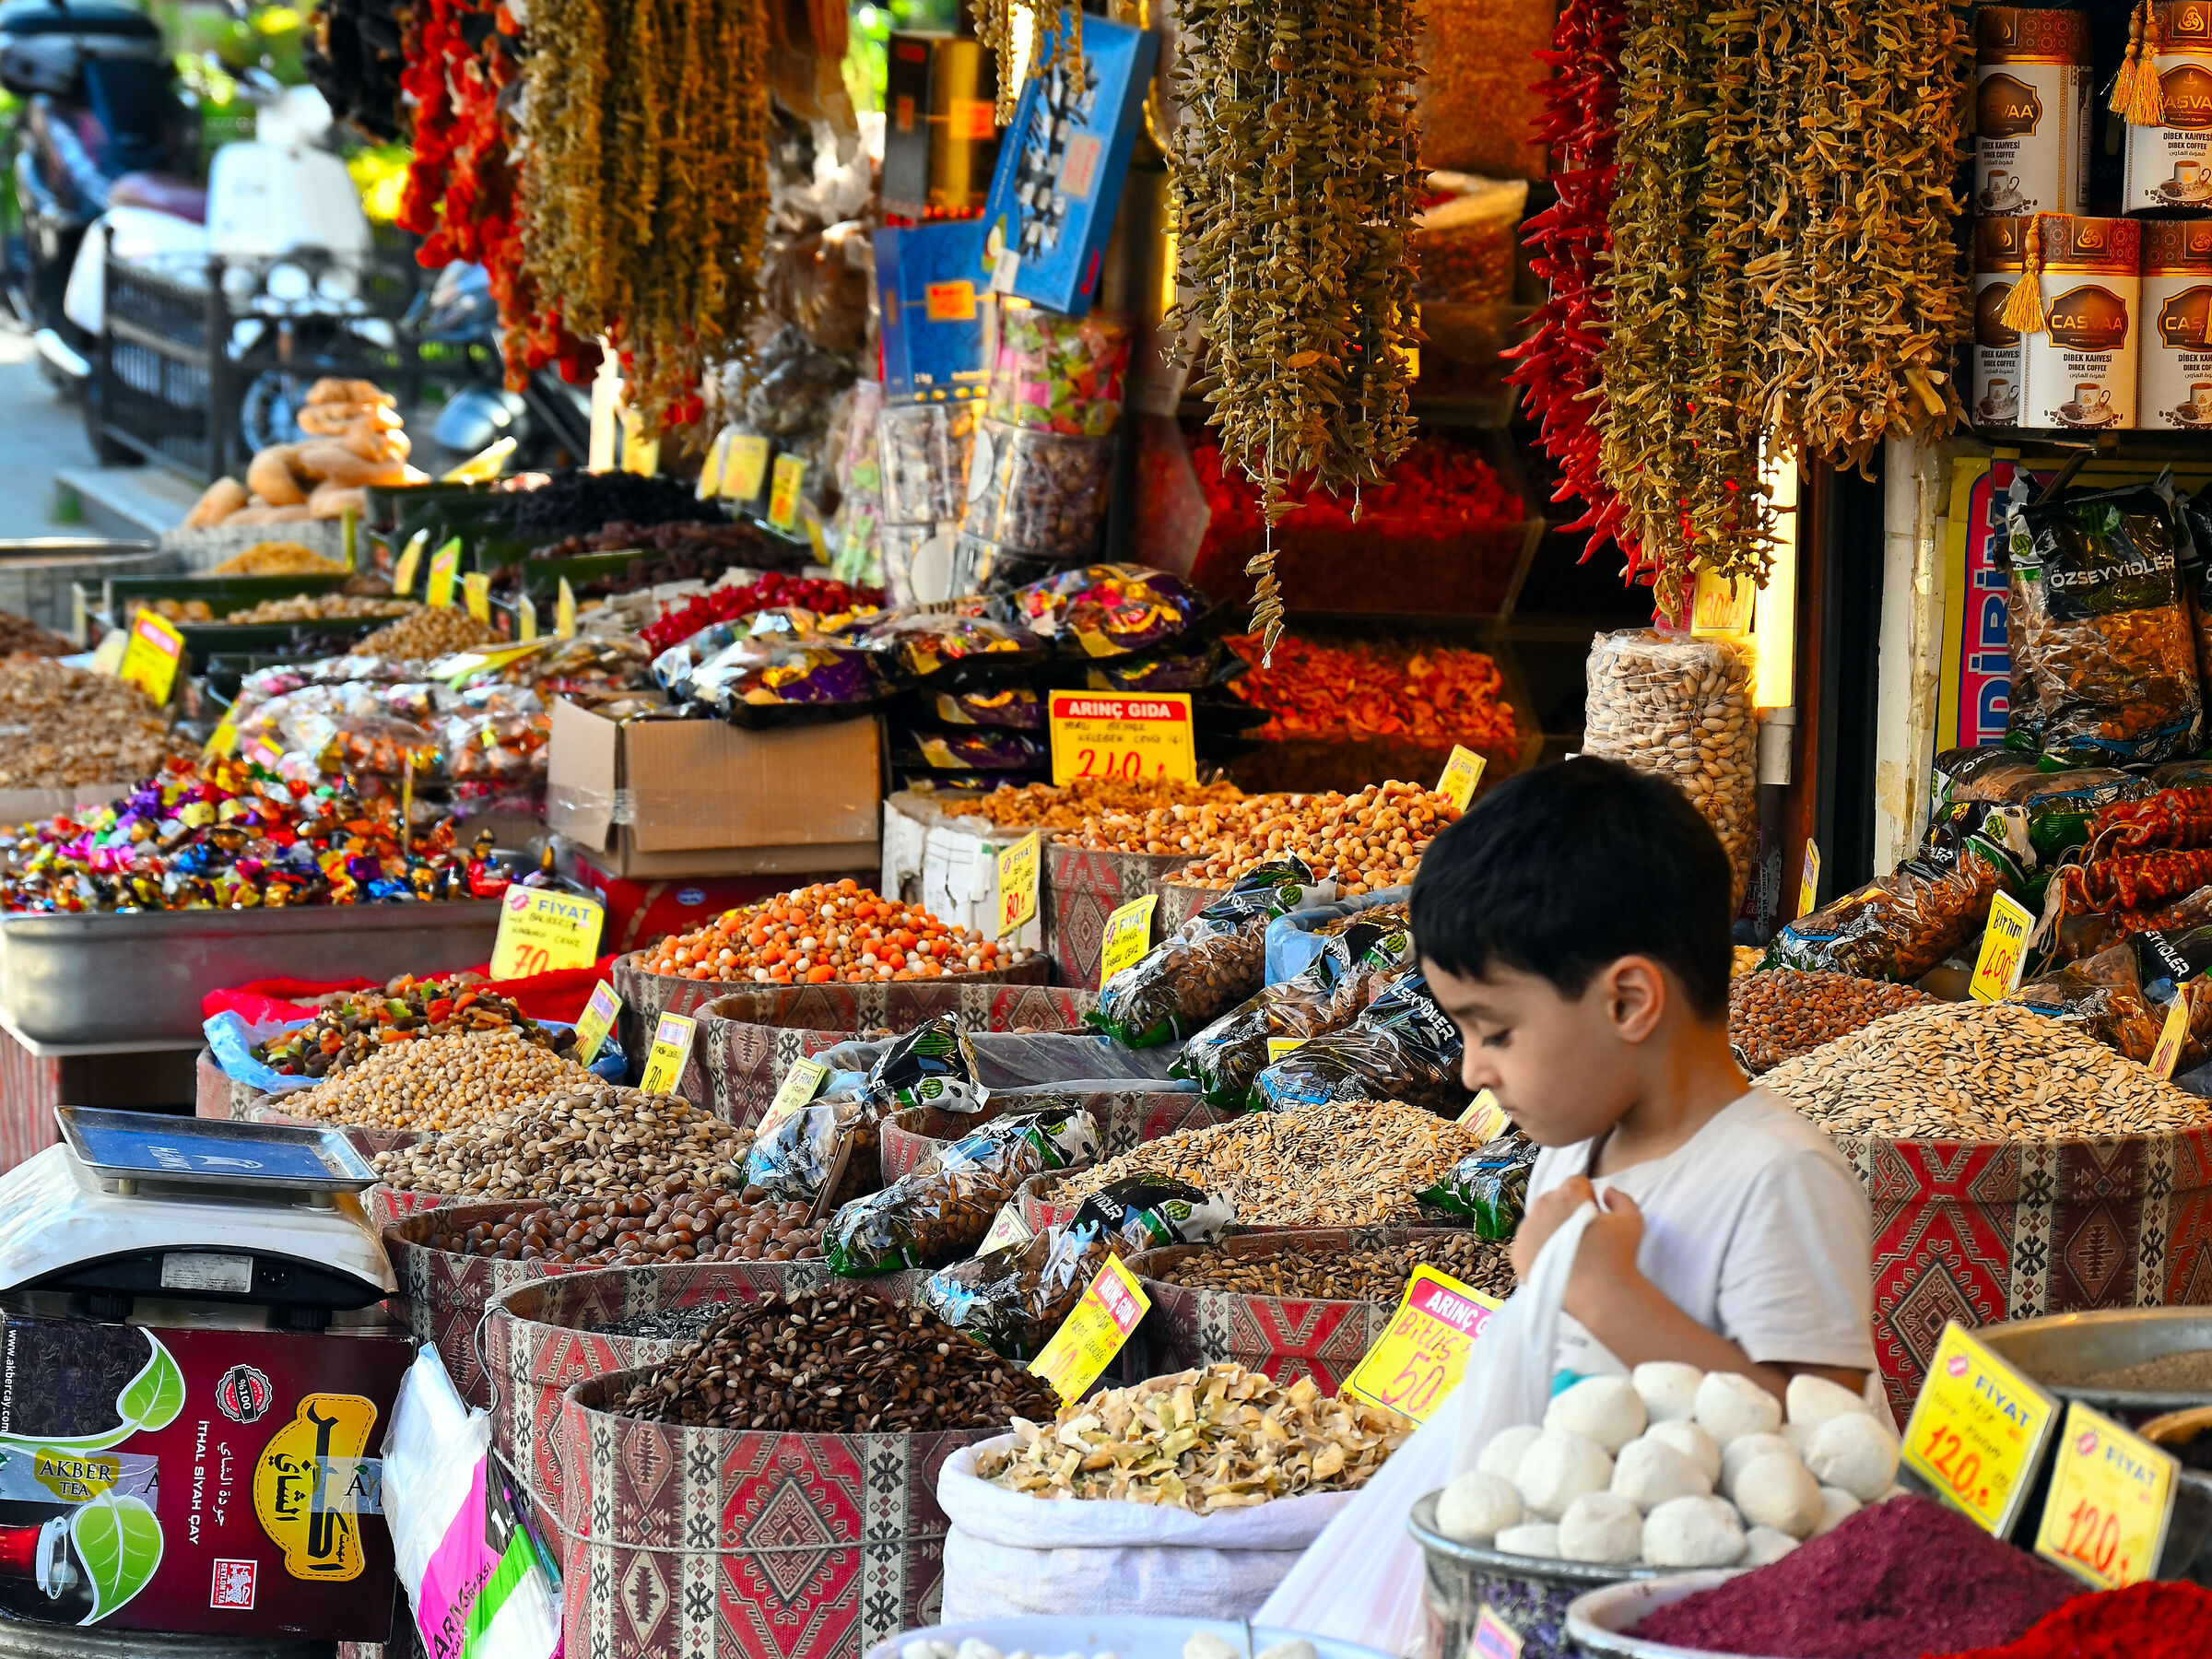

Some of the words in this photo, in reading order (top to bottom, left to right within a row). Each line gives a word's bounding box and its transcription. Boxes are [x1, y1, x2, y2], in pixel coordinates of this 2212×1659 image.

[1995, 350, 2019, 359] KAHVES
[2064, 353, 2084, 361] DİBEK
[2086, 353, 2112, 362] KAHVESİ
[2051, 556, 2175, 588] ÖZSEYYİDLER
[1069, 701, 1124, 719] ARINÇ
[1128, 703, 1171, 718] GIDA
[1006, 892, 1020, 925] 80
[512, 945, 549, 977] 70
[1098, 1276, 1122, 1312] ARINÇ
[1425, 1290, 1479, 1332] ARINÇ
[1, 1329, 17, 1432] www.akbercay.com
[236, 1378, 252, 1410] %100
[1381, 1351, 1446, 1413] 50
[1975, 1373, 2031, 1429] FİYAT
[194, 1420, 210, 1462] İTHAL
[39, 1459, 113, 1482] AKBER
[60, 1481, 90, 1497] TEA
[190, 1465, 206, 1511] SİYAH
[187, 1515, 201, 1546] ÇAY
[219, 1562, 229, 1591] CEYLON
[218, 1591, 226, 1605] TEA
